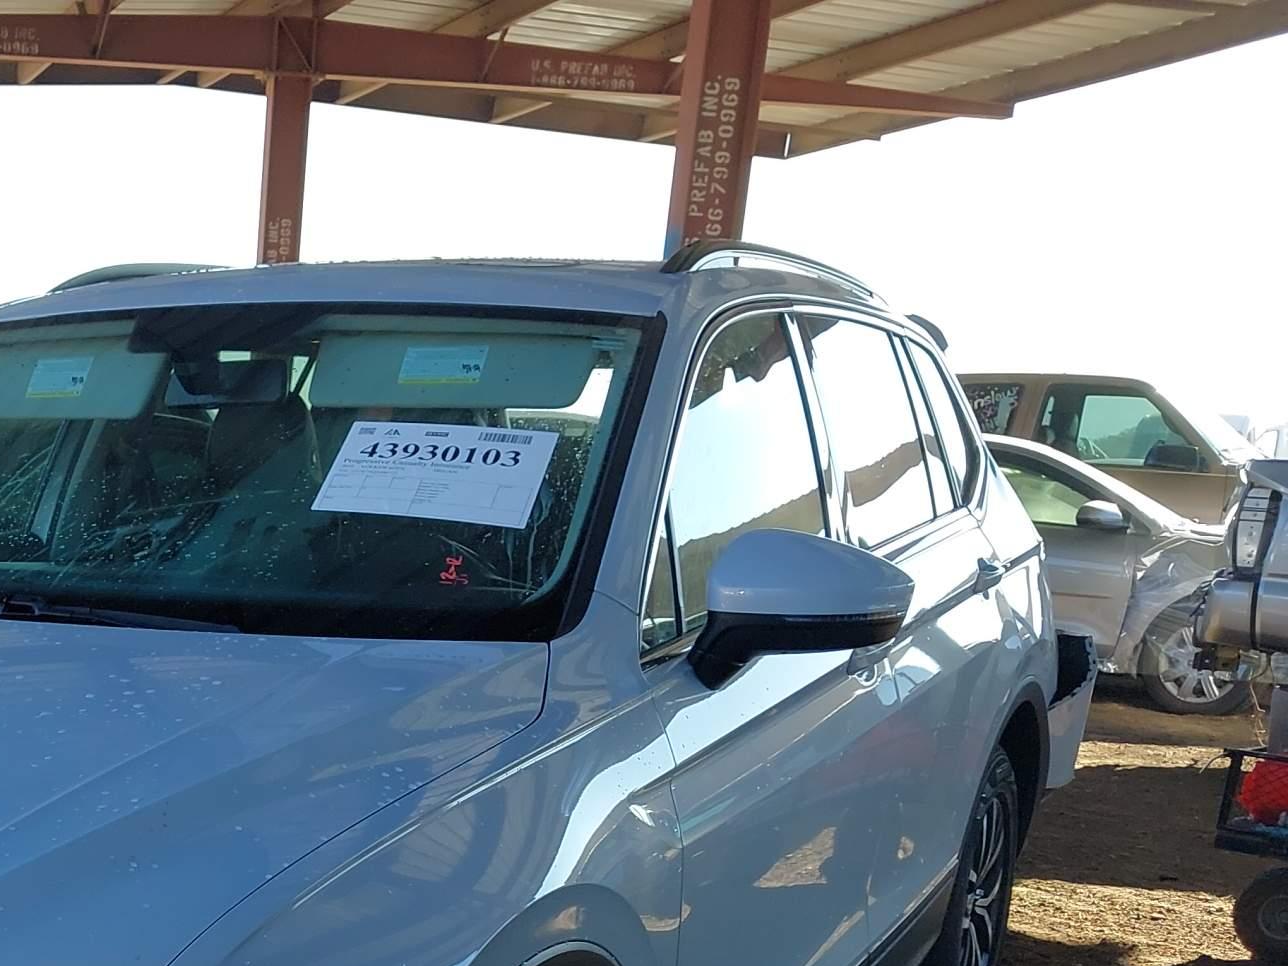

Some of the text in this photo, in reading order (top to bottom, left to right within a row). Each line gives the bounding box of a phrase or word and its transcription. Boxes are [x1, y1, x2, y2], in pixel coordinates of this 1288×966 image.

[561, 61, 609, 77] PREFAB
[688, 130, 714, 217] PREFAB
[701, 74, 722, 117] INC.
[705, 77, 740, 240] 66-799-0969
[360, 441, 521, 468] 43930103
